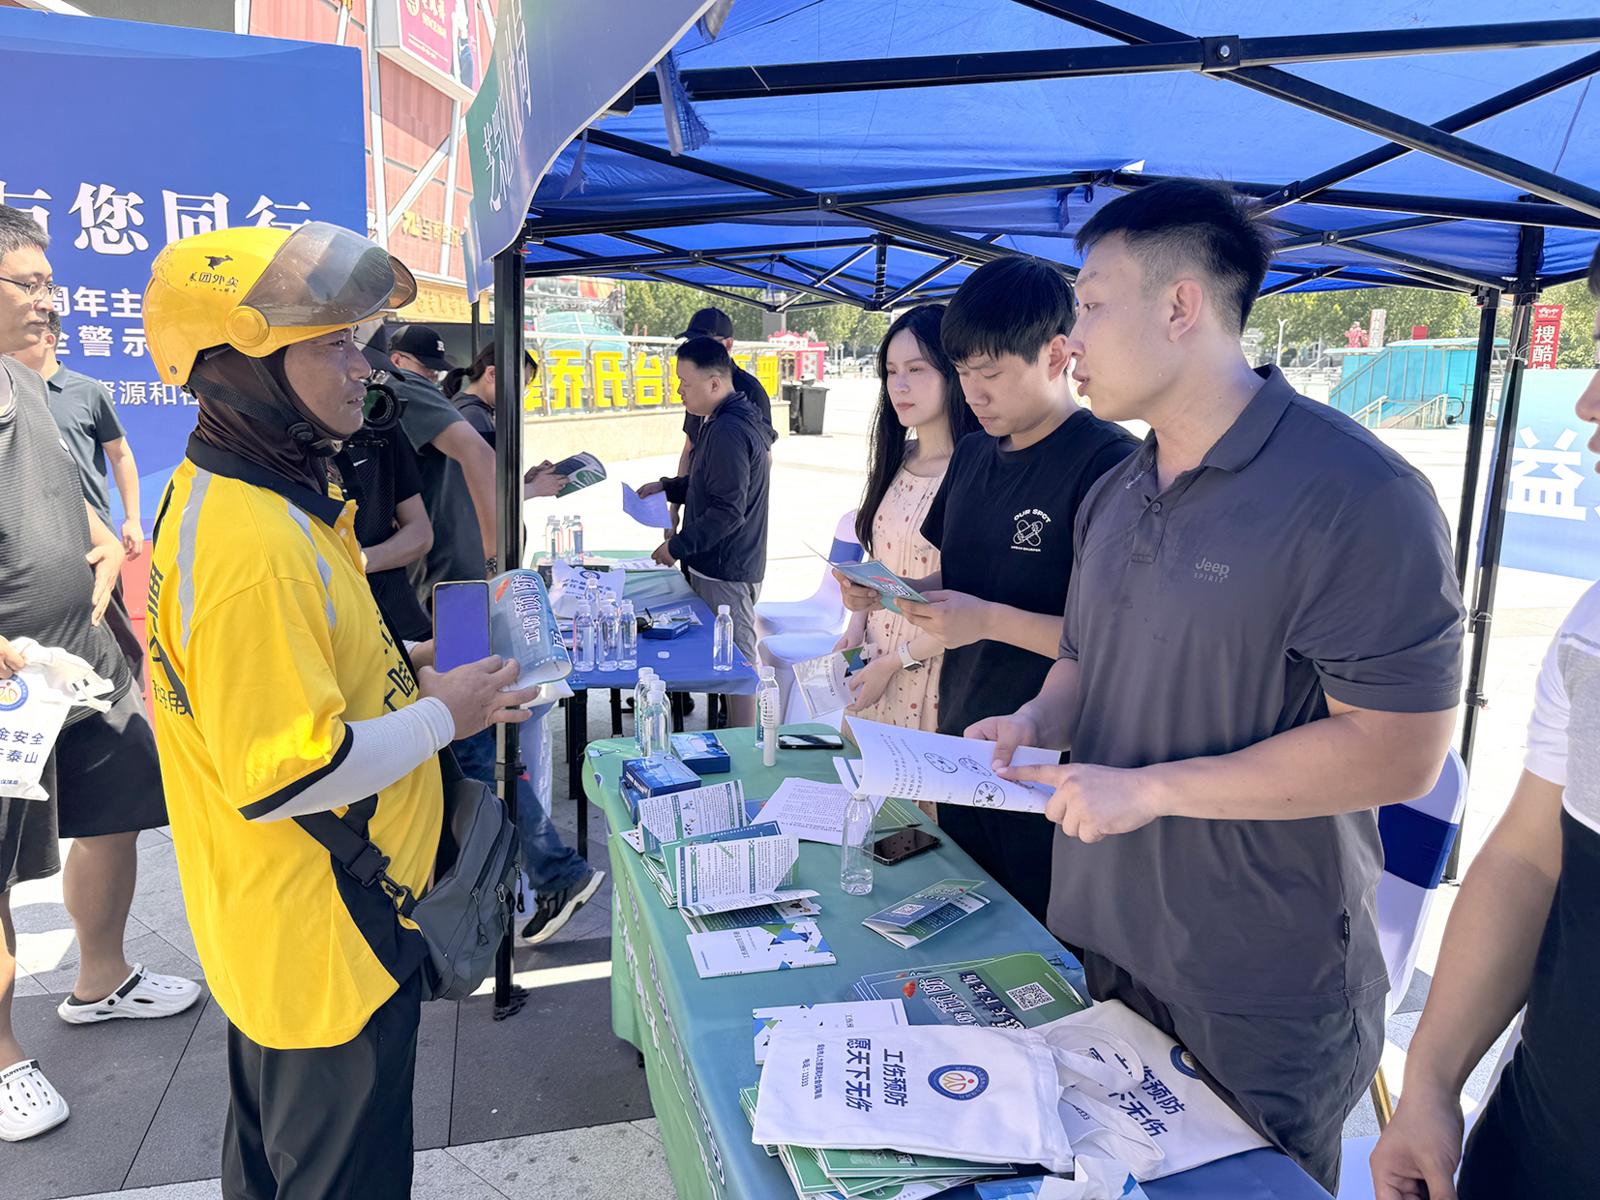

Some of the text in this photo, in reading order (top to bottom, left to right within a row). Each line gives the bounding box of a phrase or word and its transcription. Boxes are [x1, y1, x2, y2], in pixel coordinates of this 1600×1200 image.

[1531, 325, 1557, 369] 搜酷
[1013, 508, 1052, 523] OUR SPOT
[1195, 557, 1230, 577] Jeep
[0, 748, 38, 764] 泰山
[918, 976, 979, 1026] 伤预防
[846, 1037, 873, 1113] 愿天下无伤
[882, 1048, 909, 1108] 工伤预防
